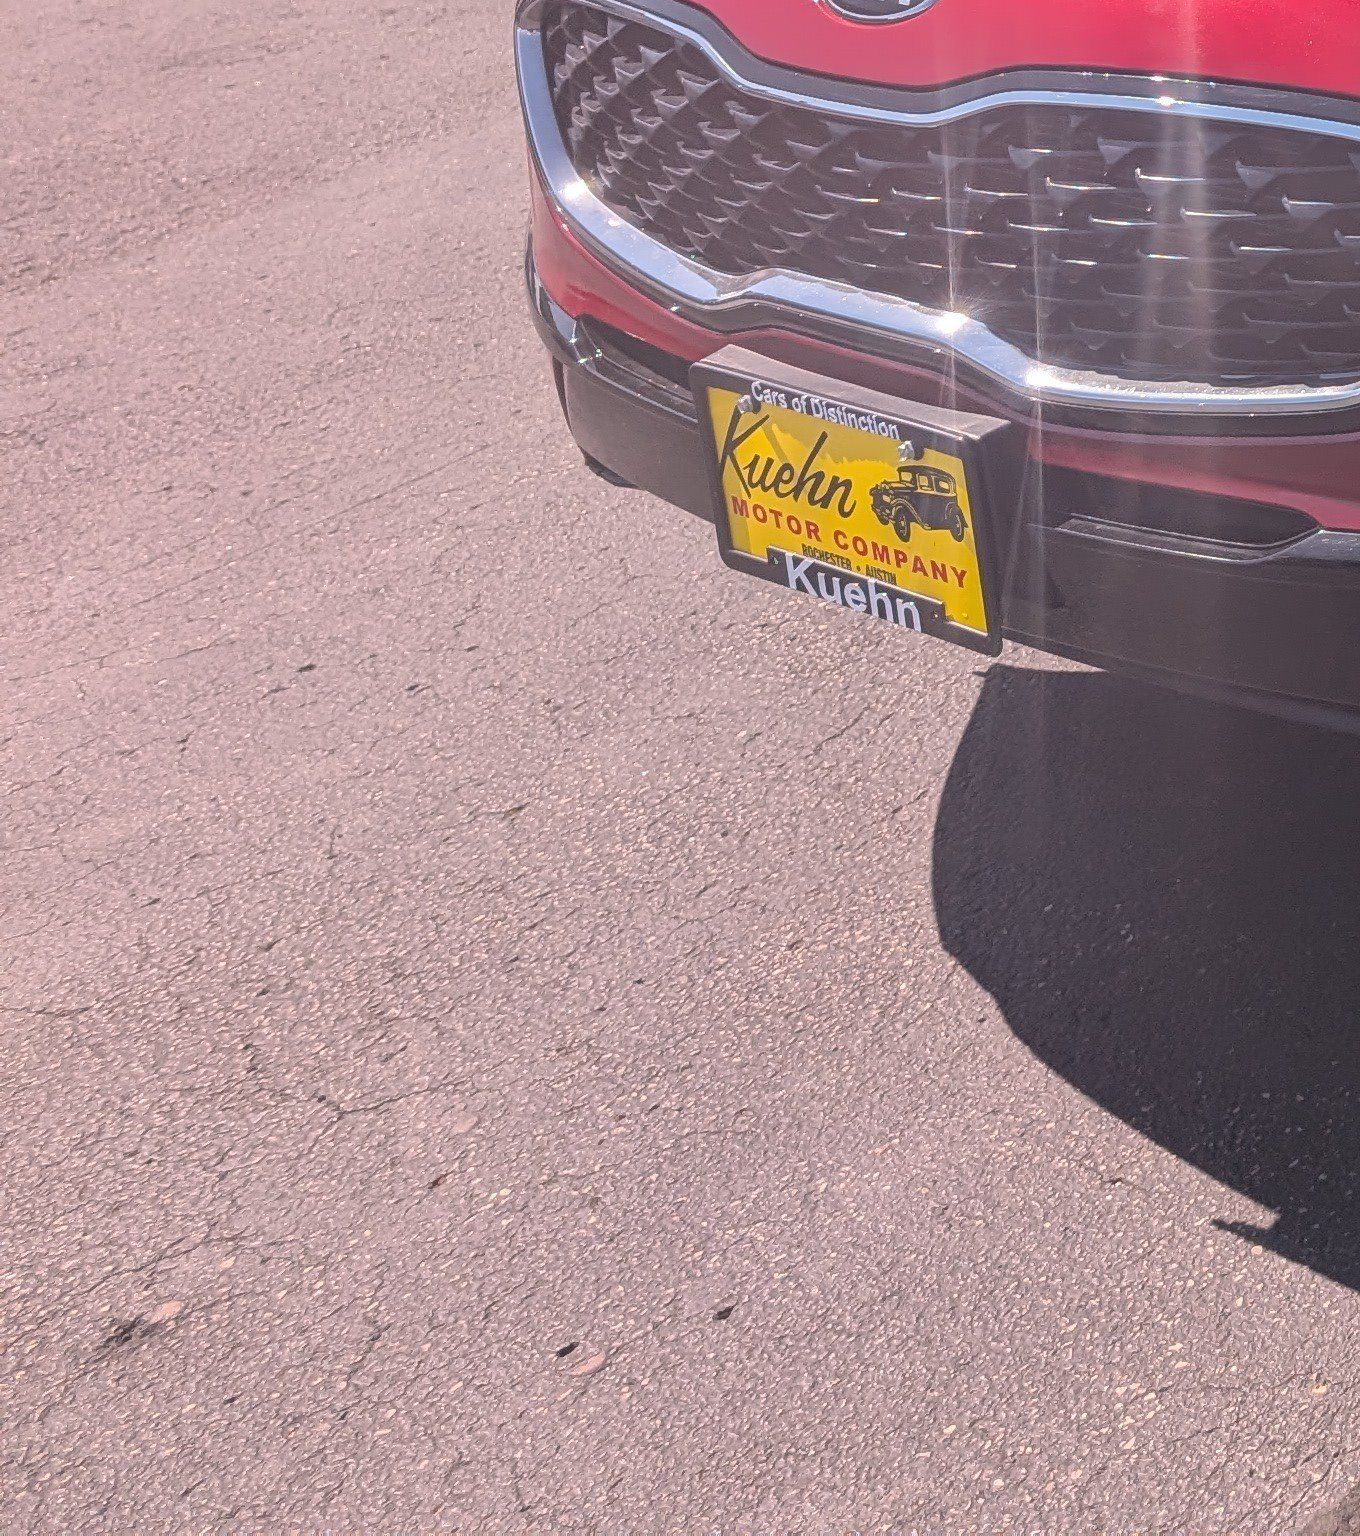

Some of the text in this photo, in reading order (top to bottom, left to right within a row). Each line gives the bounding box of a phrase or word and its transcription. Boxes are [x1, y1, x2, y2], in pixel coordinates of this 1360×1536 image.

[751, 380, 900, 440] Cars of Distinction
[718, 403, 857, 519] Kuehn
[731, 496, 968, 589] MOTOR COMPANY
[801, 543, 898, 586] ROCHESTER AUSTIN
[784, 551, 923, 635] Kuehn
